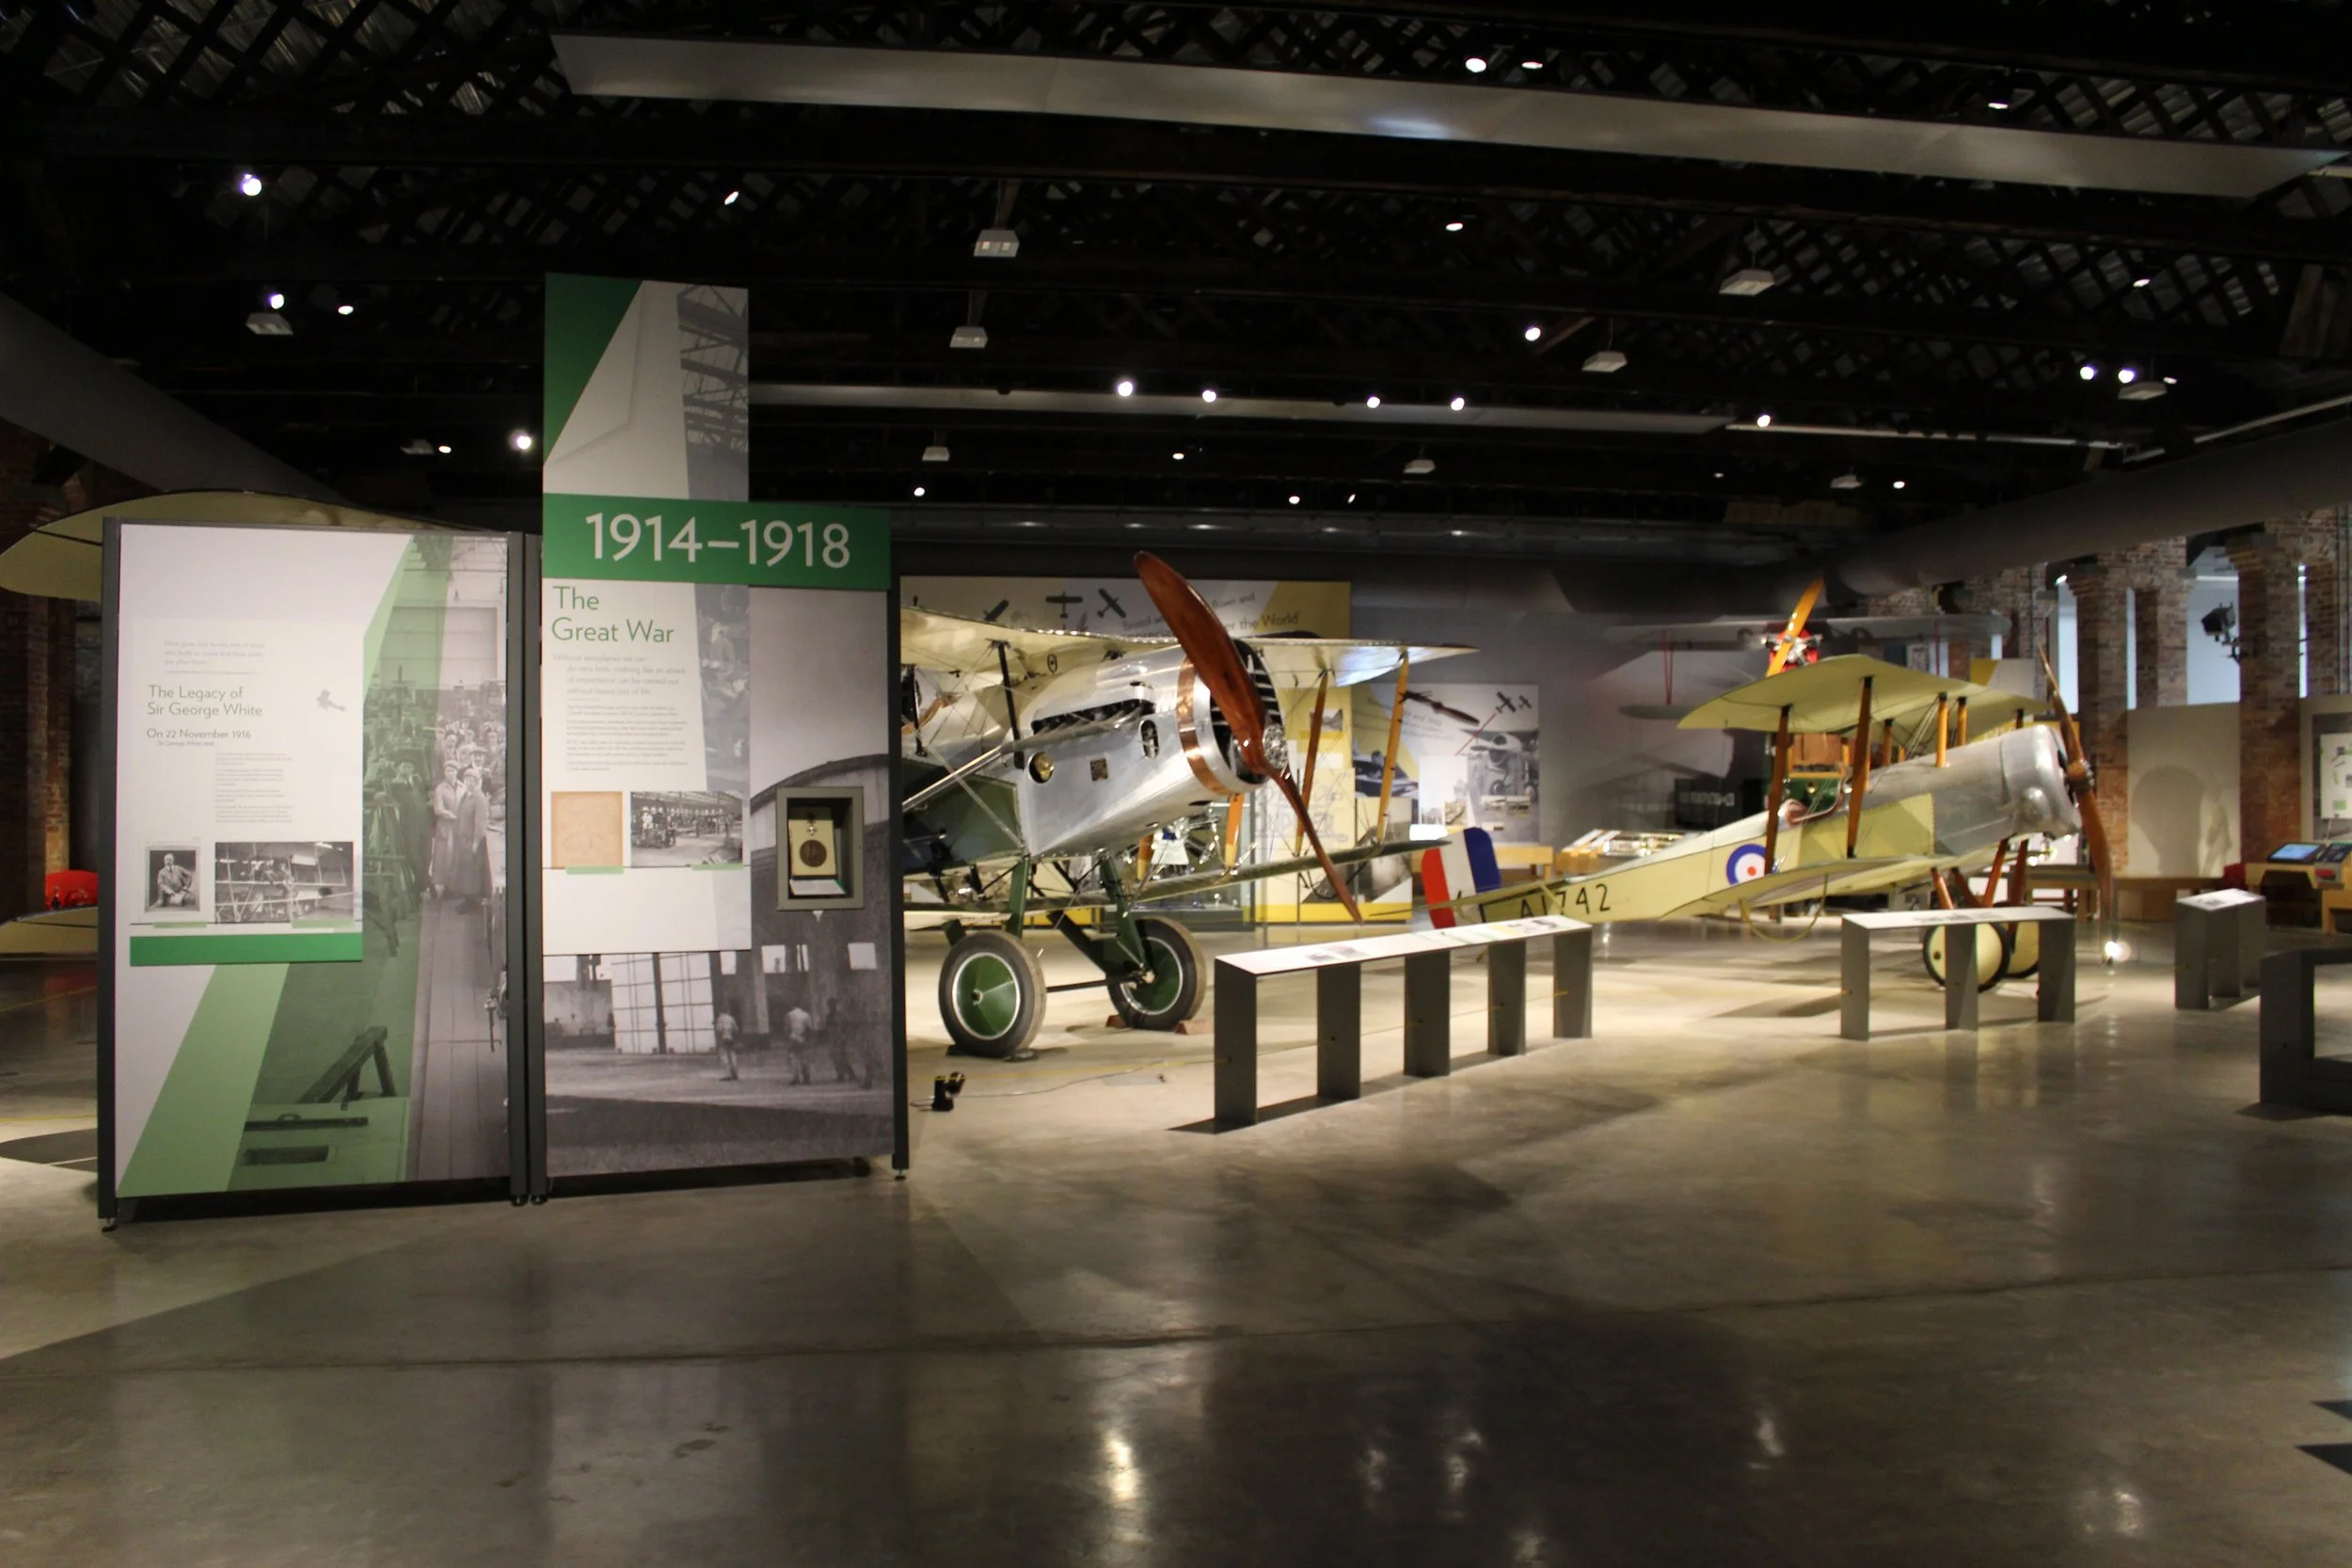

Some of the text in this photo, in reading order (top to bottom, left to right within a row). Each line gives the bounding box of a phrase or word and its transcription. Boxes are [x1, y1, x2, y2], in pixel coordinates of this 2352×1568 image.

[552, 585, 599, 610] The
[1261, 610, 1299, 626] World
[551, 617, 675, 643] Great War
[148, 684, 244, 702] The Legacy of
[147, 701, 263, 719] Sir George White
[146, 728, 252, 739] On 22 November 1916
